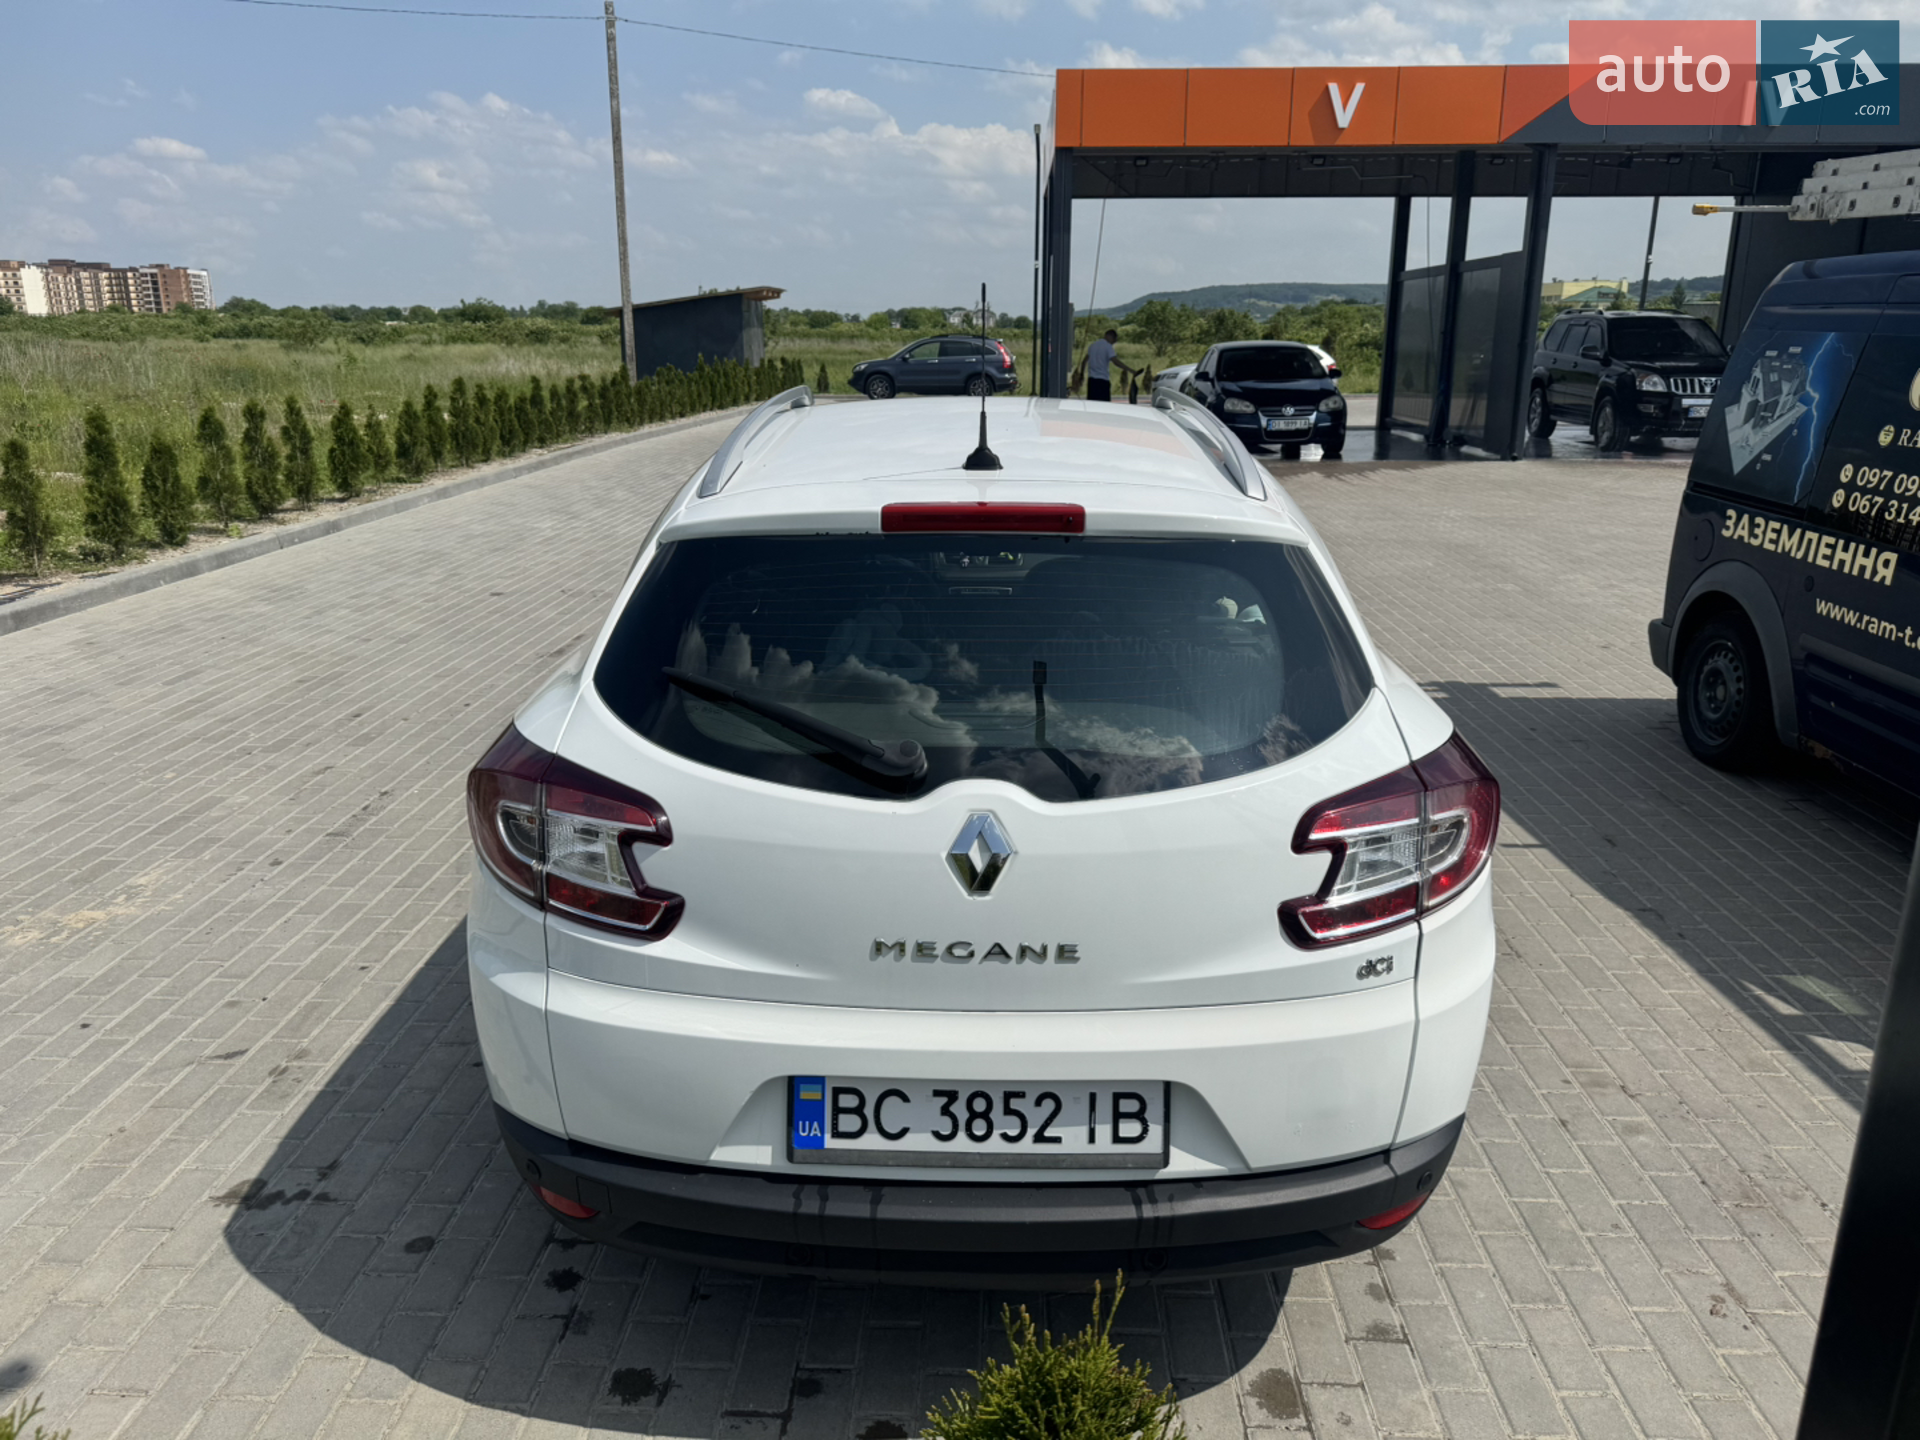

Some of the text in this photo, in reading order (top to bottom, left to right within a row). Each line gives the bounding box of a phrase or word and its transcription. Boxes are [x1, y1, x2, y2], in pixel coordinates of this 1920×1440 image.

[1327, 82, 1366, 128] V
[1856, 466, 1920, 499] 097 09
[1848, 491, 1885, 519] 067
[1721, 508, 1899, 586] ЗАЗЕМЛЕННЯ
[872, 938, 1080, 963] MEGANE
[798, 1086, 1151, 1145] UA BC 3852 IB
